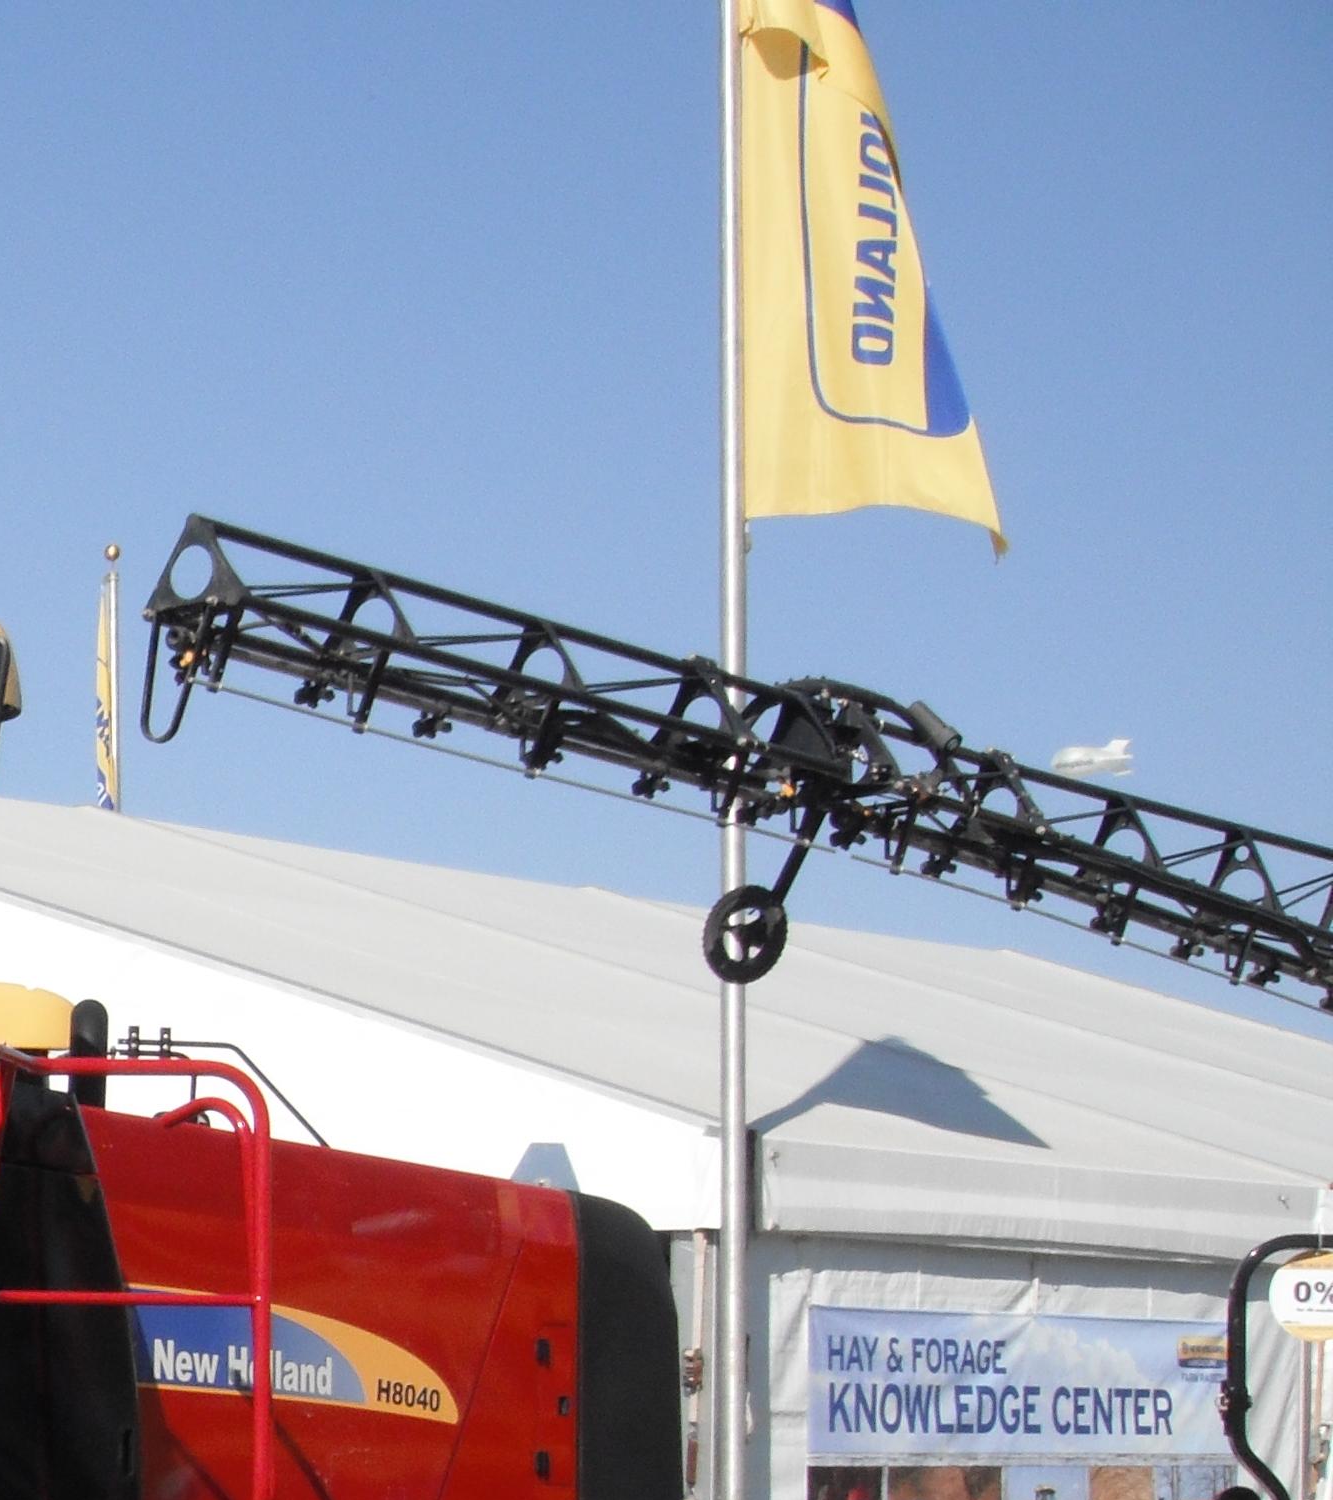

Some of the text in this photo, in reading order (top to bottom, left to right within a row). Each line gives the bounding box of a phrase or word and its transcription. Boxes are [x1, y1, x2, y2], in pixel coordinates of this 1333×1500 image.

[153, 1338, 333, 1396] New Hlland
[827, 1335, 1008, 1375] HAY & FORAGE
[376, 1378, 441, 1412] H8040
[828, 1382, 1174, 1436] KNOWLEDGE CENTER
